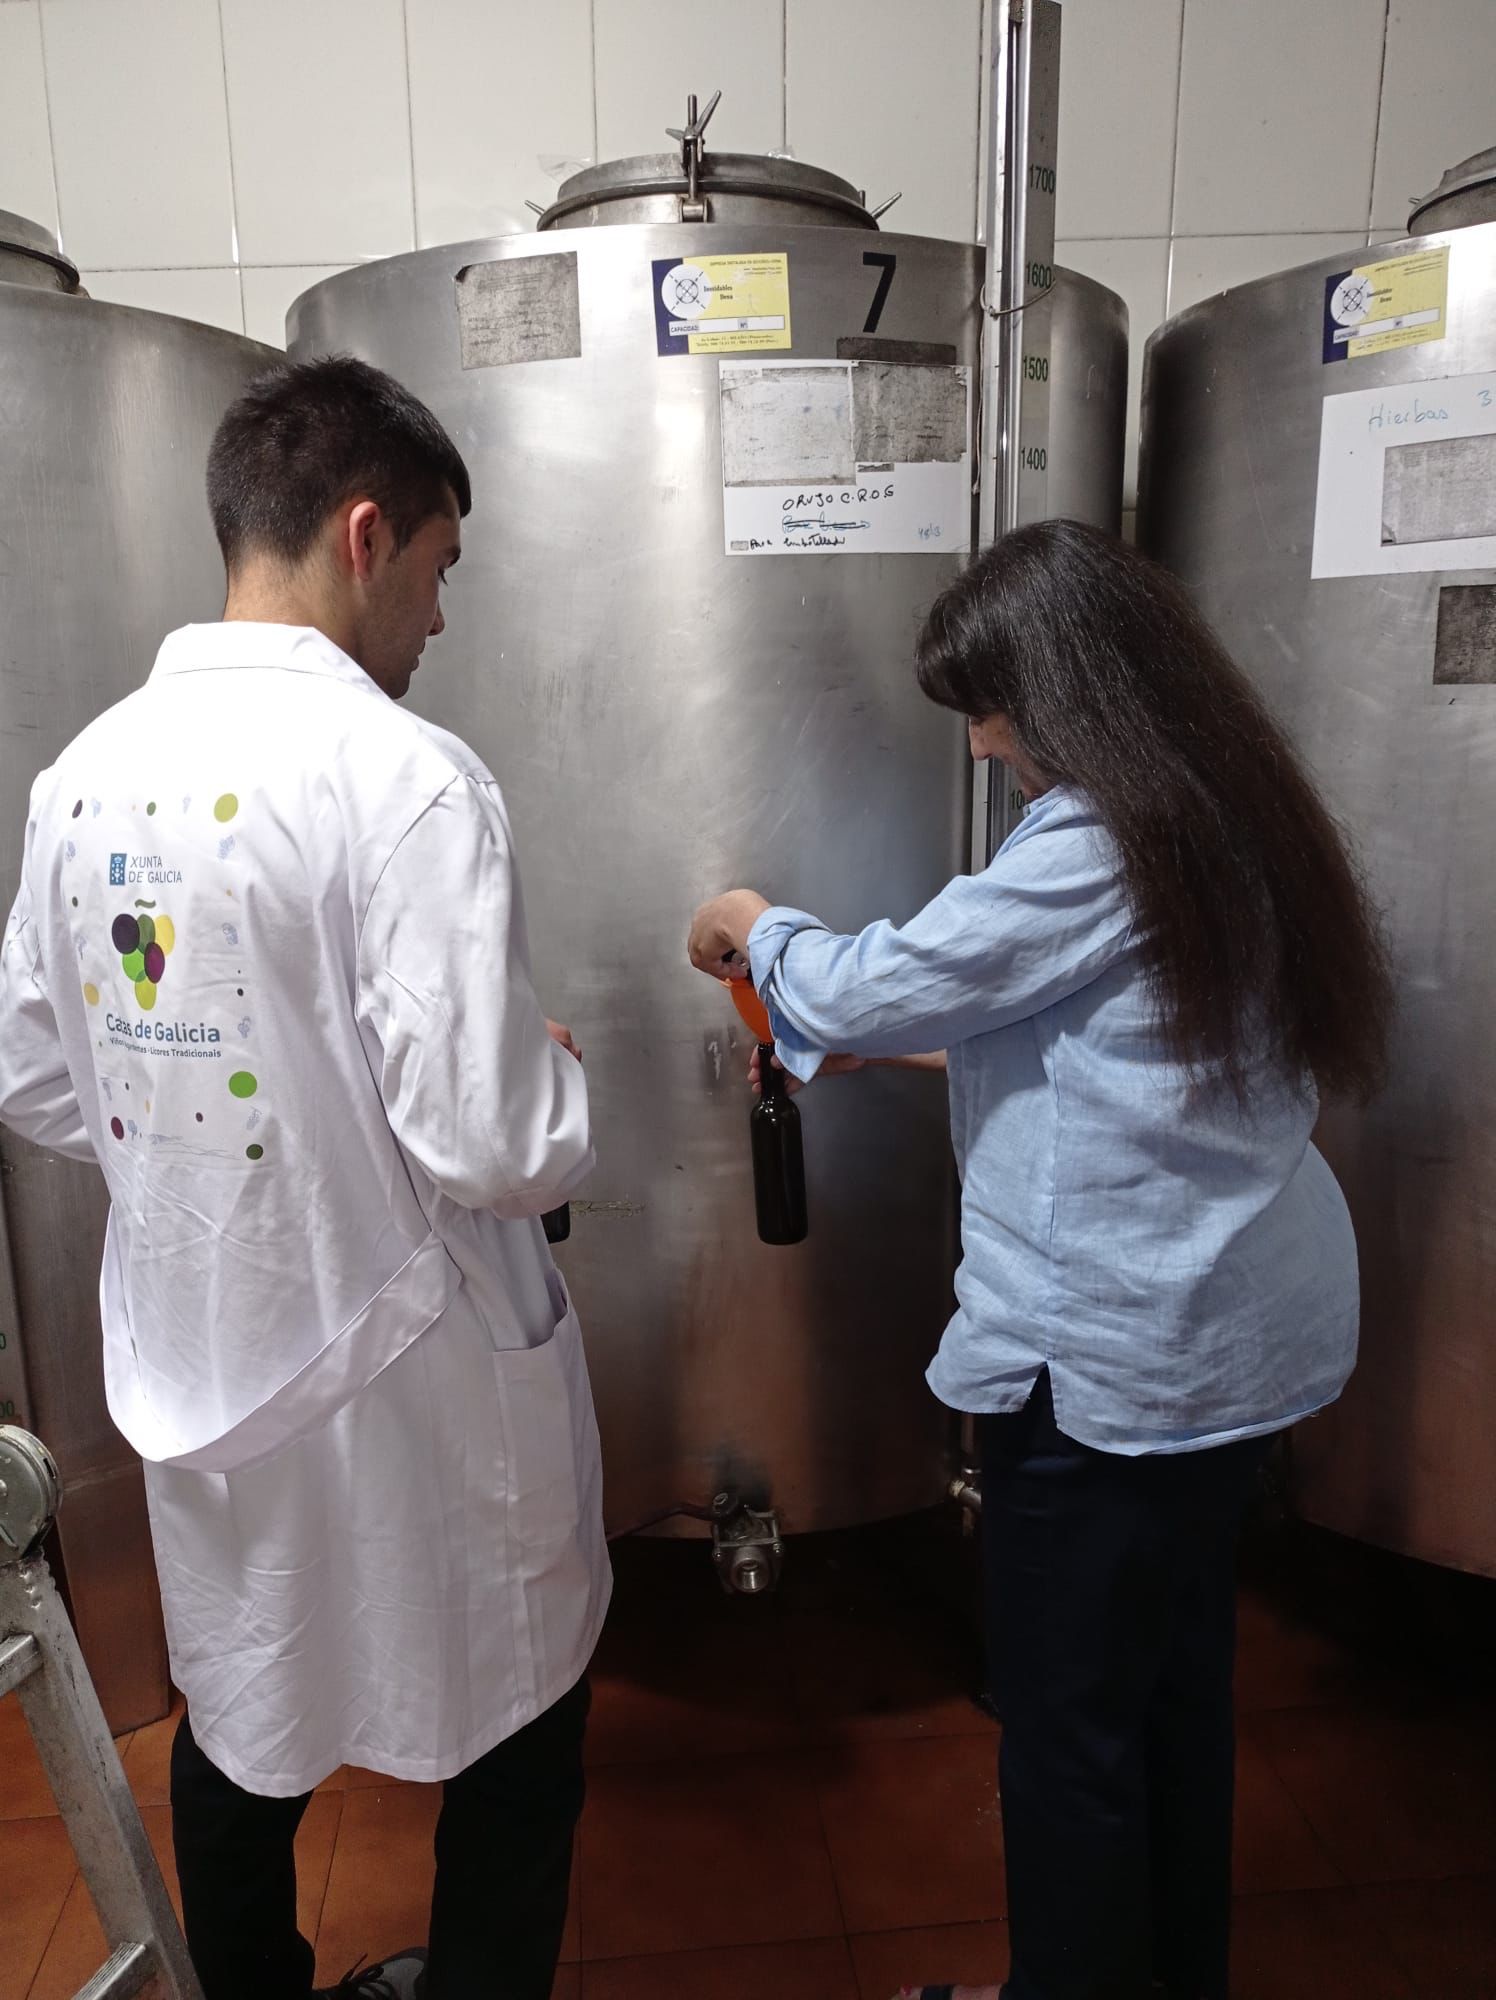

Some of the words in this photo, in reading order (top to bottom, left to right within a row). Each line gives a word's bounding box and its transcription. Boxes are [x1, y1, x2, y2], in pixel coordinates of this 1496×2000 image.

[1029, 164, 1056, 194] 1700
[1026, 262, 1052, 289] 1600
[862, 251, 897, 333] 7
[1023, 356, 1048, 382] 1500
[1368, 398, 1449, 432] Hierbas
[1021, 446, 1047, 470] 1400
[130, 856, 163, 868] XUNTA
[128, 871, 144, 883] DE
[147, 870, 183, 883] GALICIA
[134, 1018, 152, 1040] de
[154, 1021, 221, 1043] Galicia
[171, 1048, 222, 1059] Tradicionais
